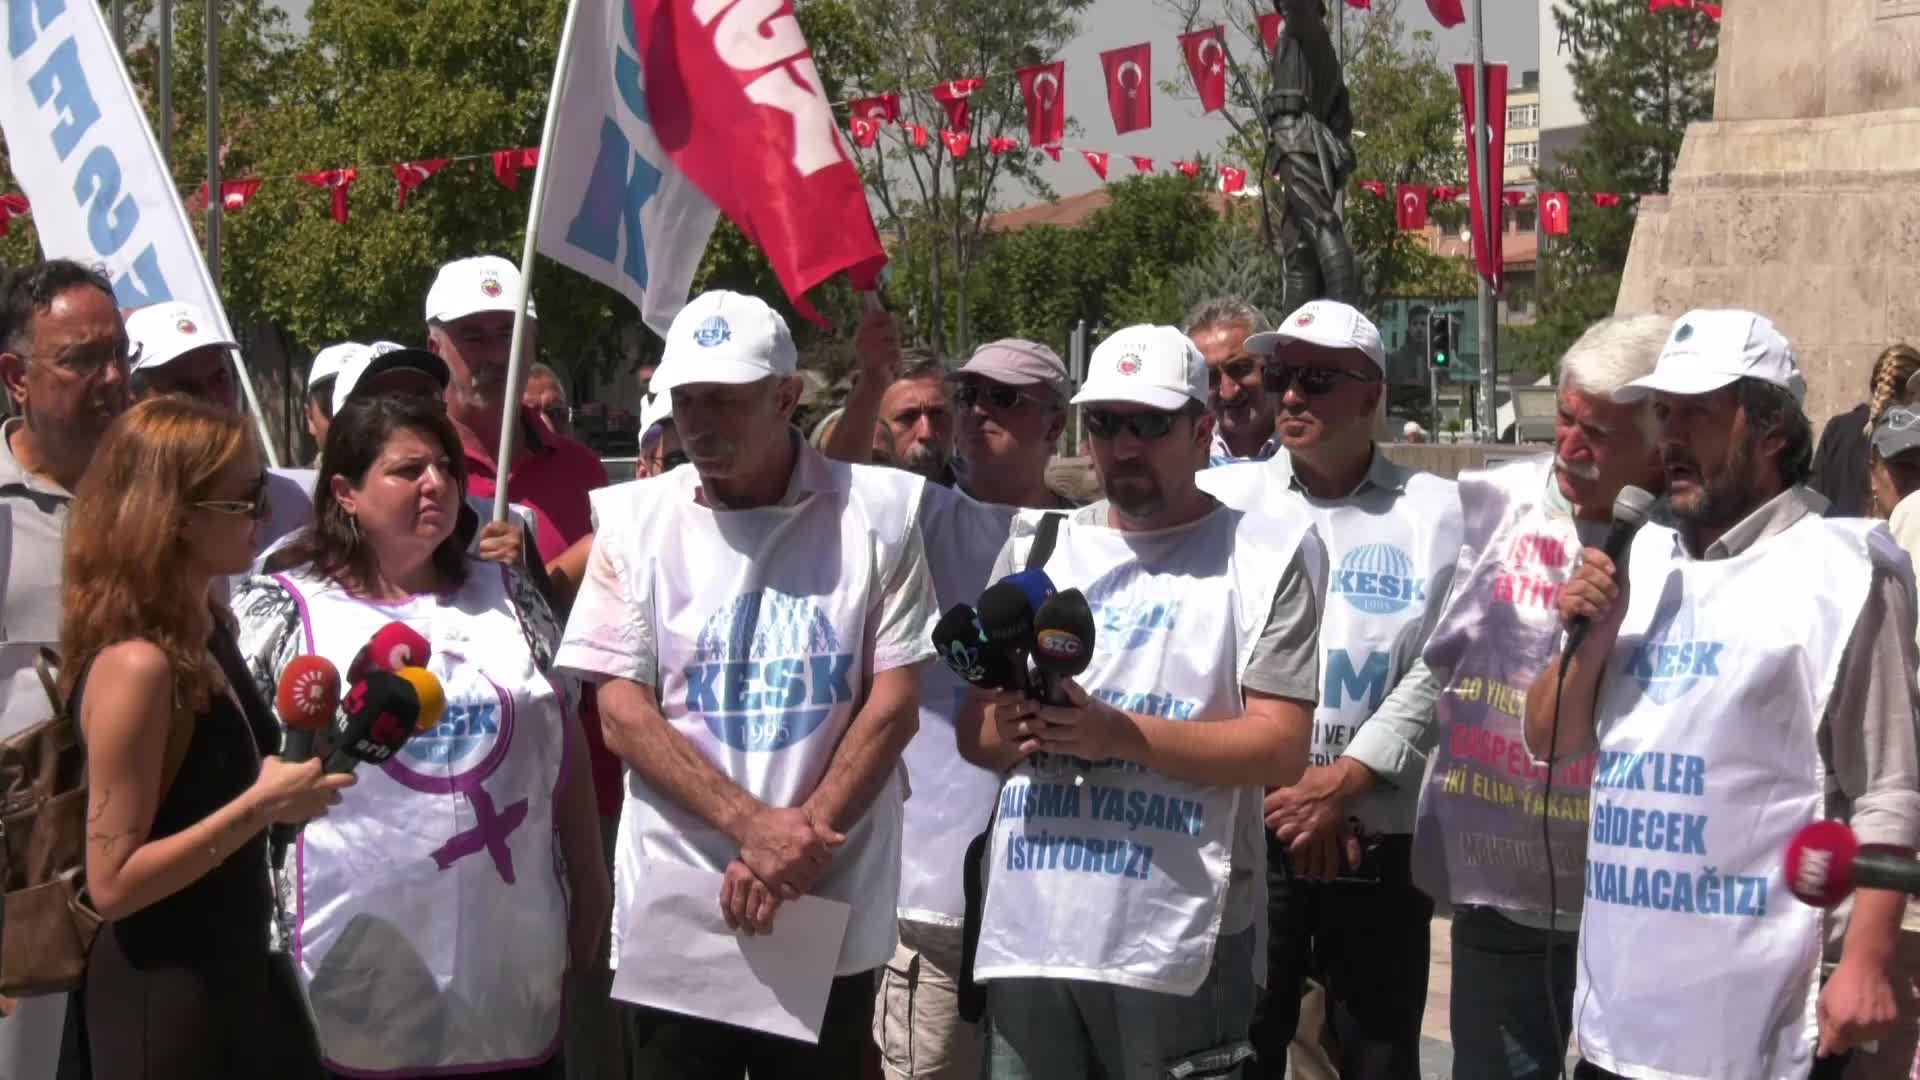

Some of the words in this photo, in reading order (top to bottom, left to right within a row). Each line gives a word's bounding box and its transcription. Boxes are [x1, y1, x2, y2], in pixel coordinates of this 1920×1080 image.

[1331, 569, 1425, 601] KESK
[1624, 641, 1724, 677] KESK
[684, 652, 853, 712] KESK
[741, 721, 790, 744] 1995
[1325, 724, 1345, 746] VE
[1001, 783, 1080, 825] ALIŞMA
[1593, 799, 1708, 856] GİDECEK
[1007, 829, 1154, 881] İSTİYORUZ!
[1594, 859, 1768, 917] KALACAĞIZ!
